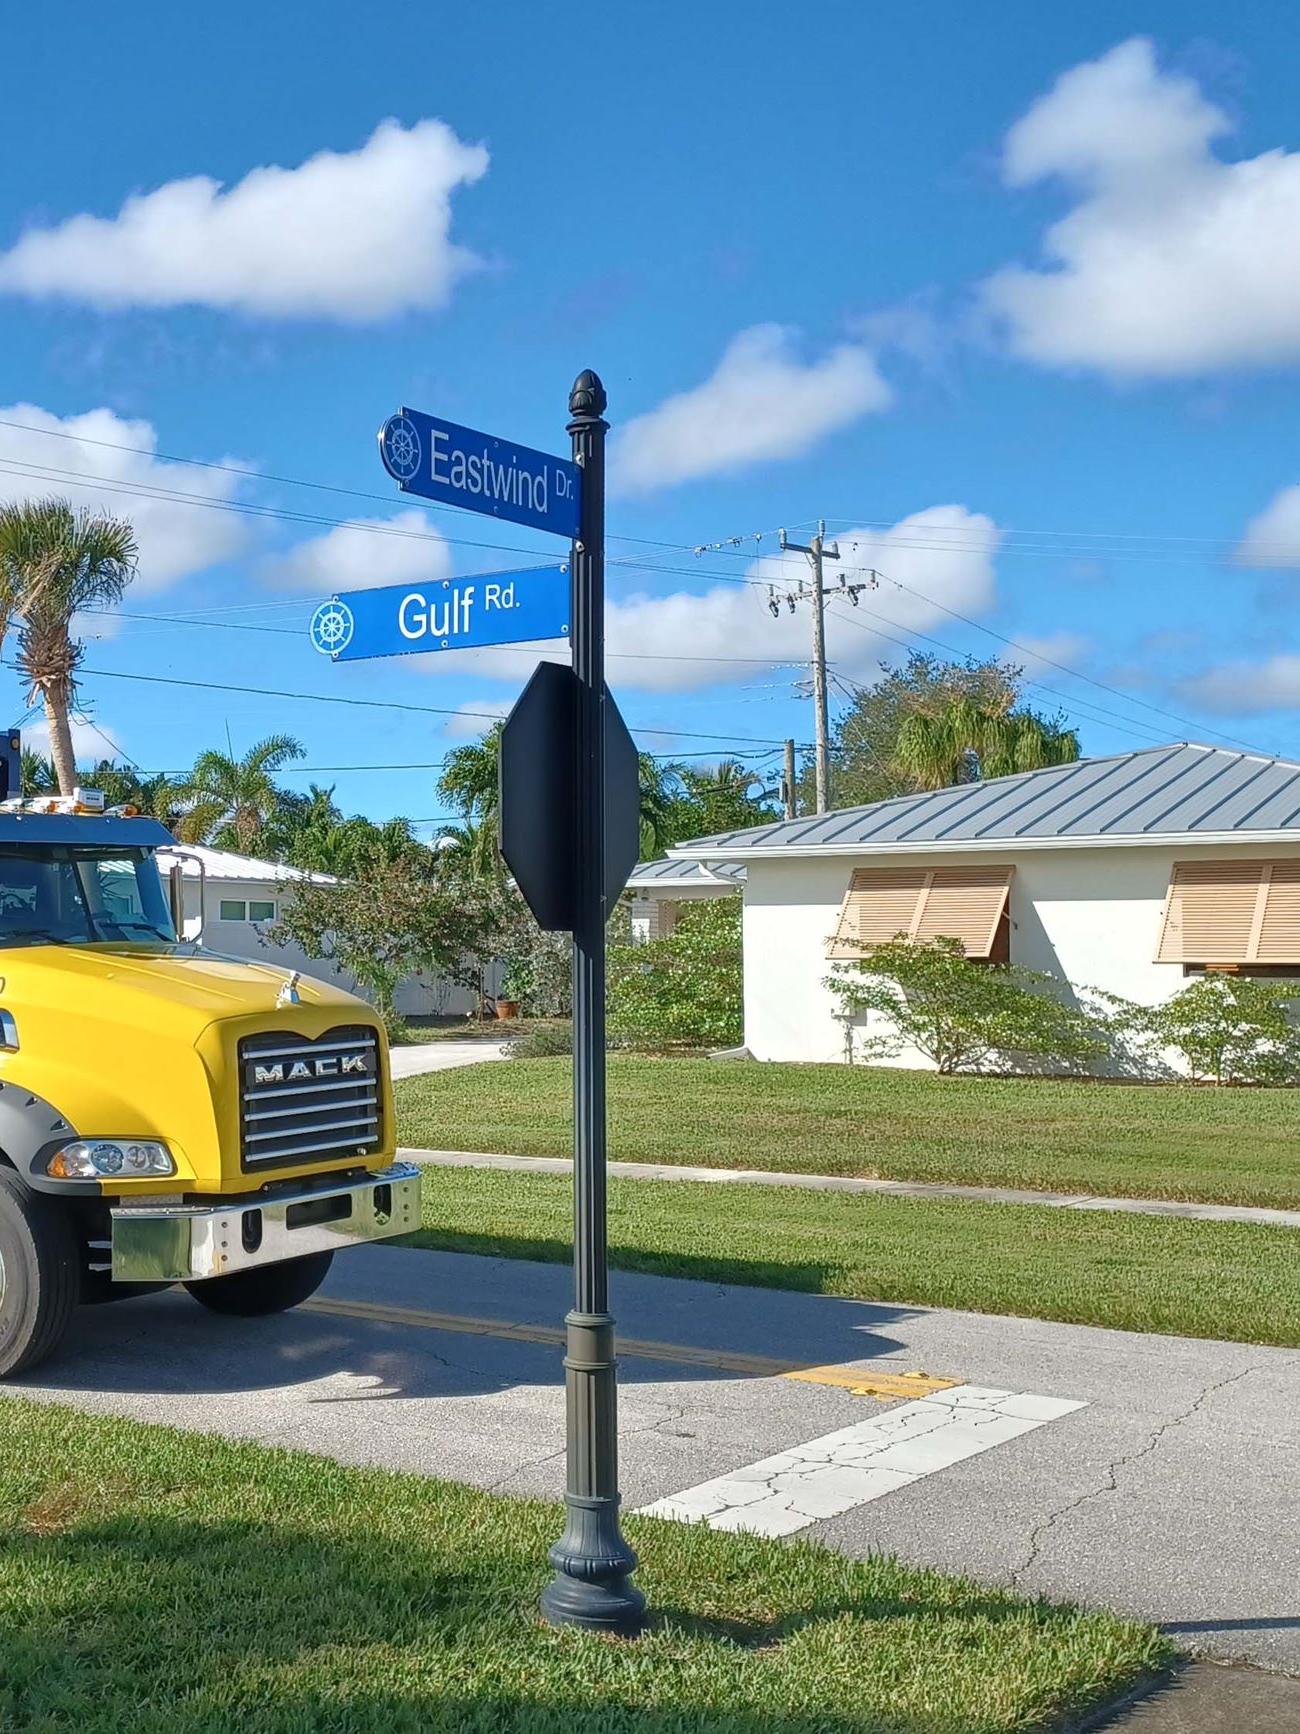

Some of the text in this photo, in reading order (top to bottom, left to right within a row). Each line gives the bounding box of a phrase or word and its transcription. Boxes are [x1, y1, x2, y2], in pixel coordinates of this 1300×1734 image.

[430, 428, 575, 513] Eastwind Dr.
[398, 583, 521, 639] Gulf Rd.
[255, 1054, 368, 1083] MACK
